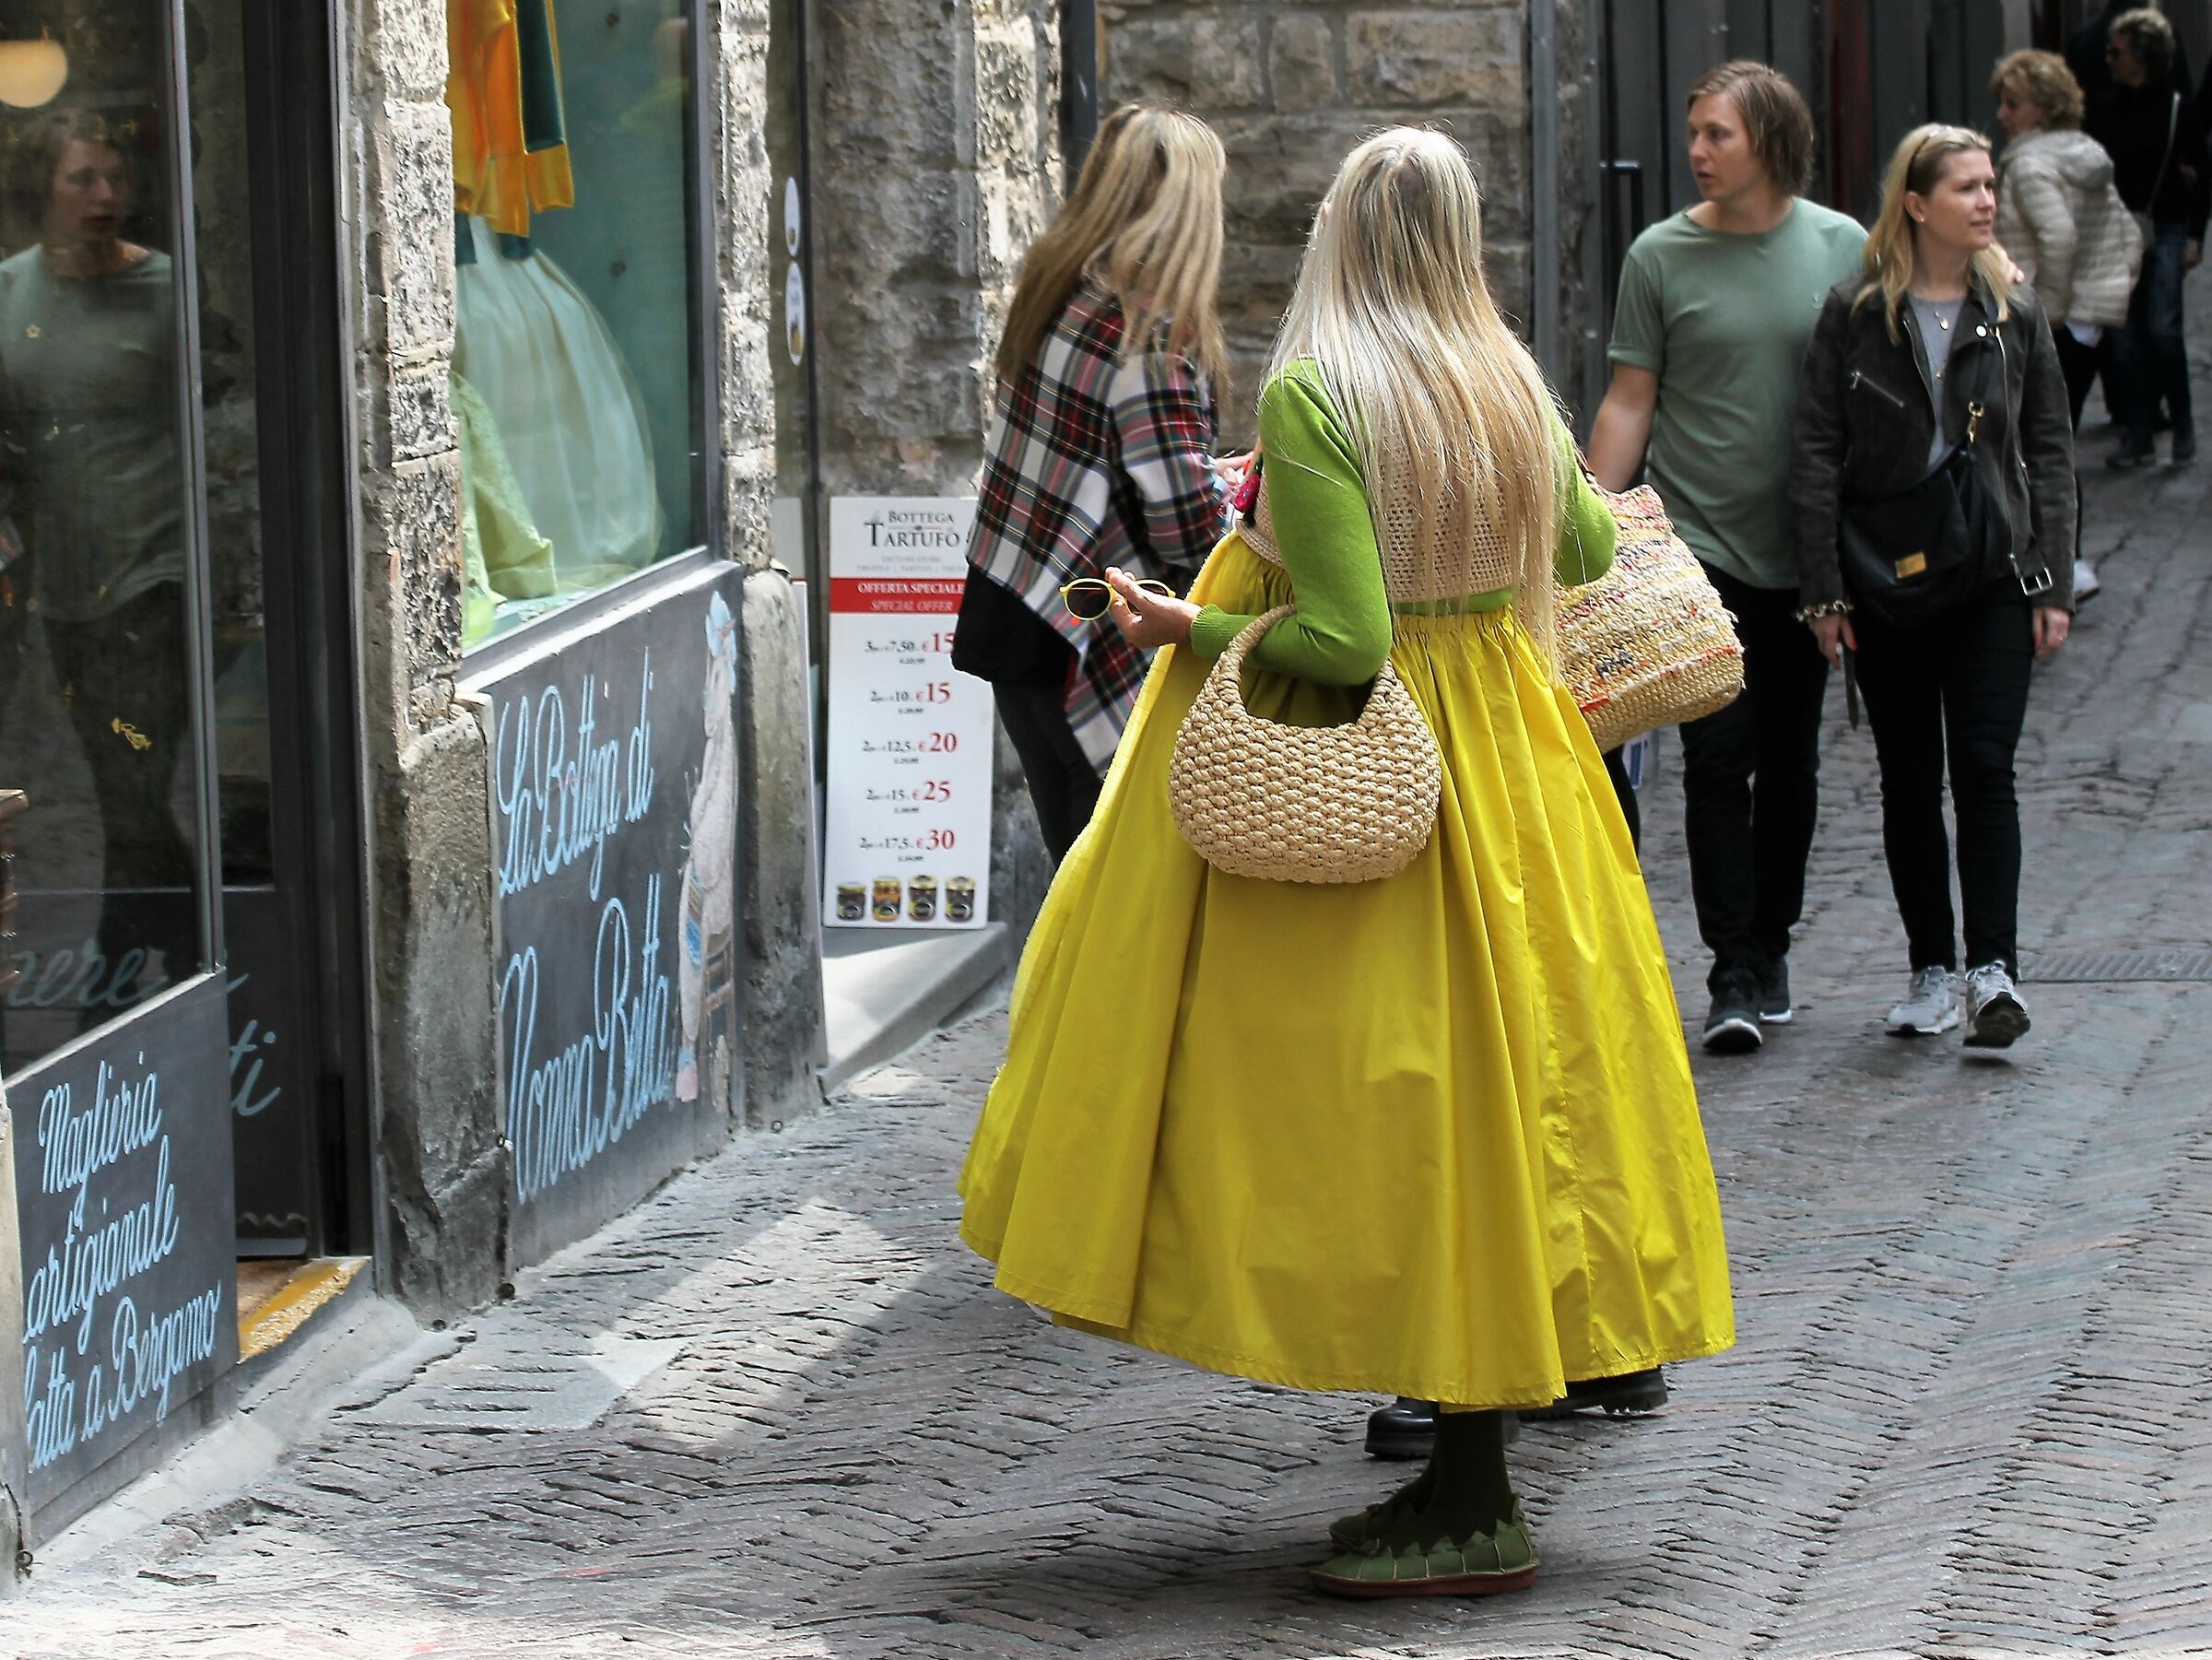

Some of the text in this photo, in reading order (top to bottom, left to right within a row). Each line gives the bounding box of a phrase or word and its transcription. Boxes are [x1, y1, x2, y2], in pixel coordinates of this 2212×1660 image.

[857, 582, 909, 595] OFFERTA
[864, 521, 960, 548] TARTUFO
[888, 511, 955, 524] BOTTEGA
[870, 600, 953, 612] SPECIAL OFFER
[496, 695, 535, 901] La
[625, 645, 654, 824] di
[38, 1050, 162, 1232] Maglieria
[500, 945, 597, 1206] Nonna
[22, 1134, 180, 1357] artigianale
[80, 1363, 106, 1442] a
[108, 1278, 222, 1429] Bergamo
